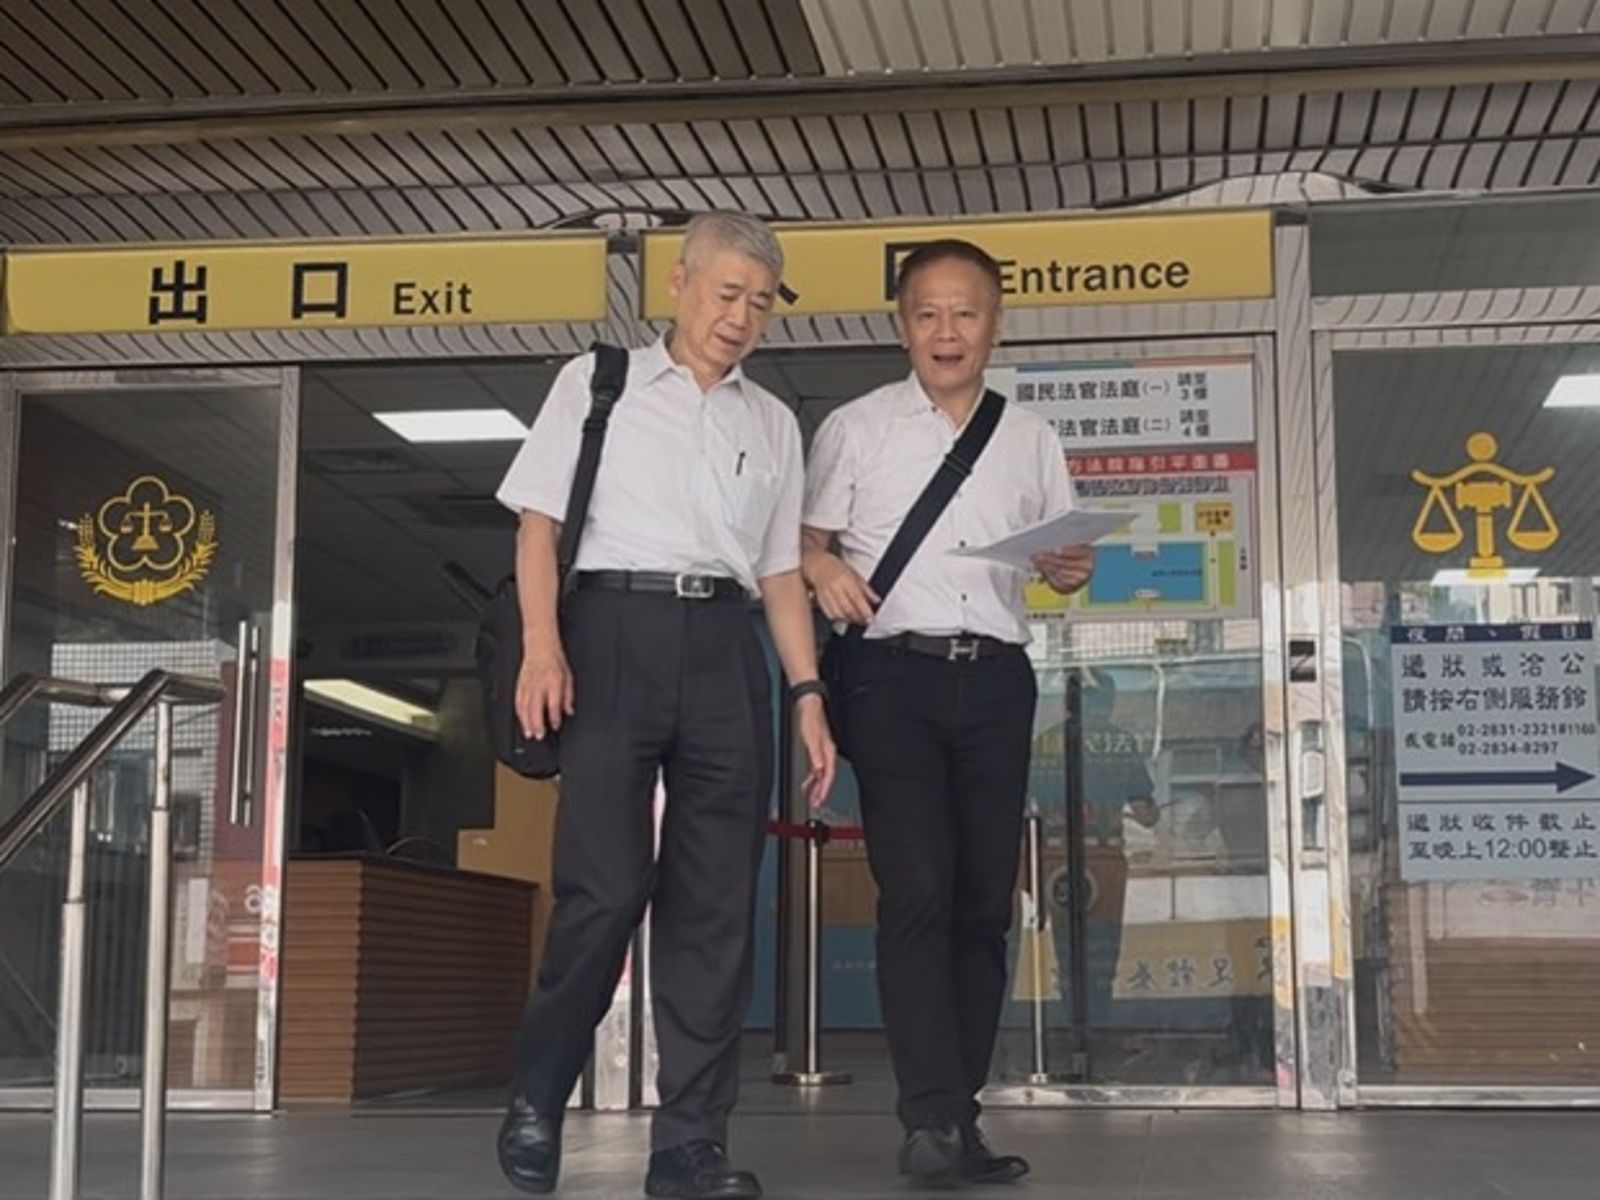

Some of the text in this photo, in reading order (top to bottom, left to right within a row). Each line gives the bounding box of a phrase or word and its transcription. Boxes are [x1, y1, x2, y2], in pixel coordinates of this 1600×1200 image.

[149, 261, 472, 325] 出口 Exit
[1001, 259, 1190, 295] Entrance
[1402, 685, 1588, 713] 請按右側服務鈴
